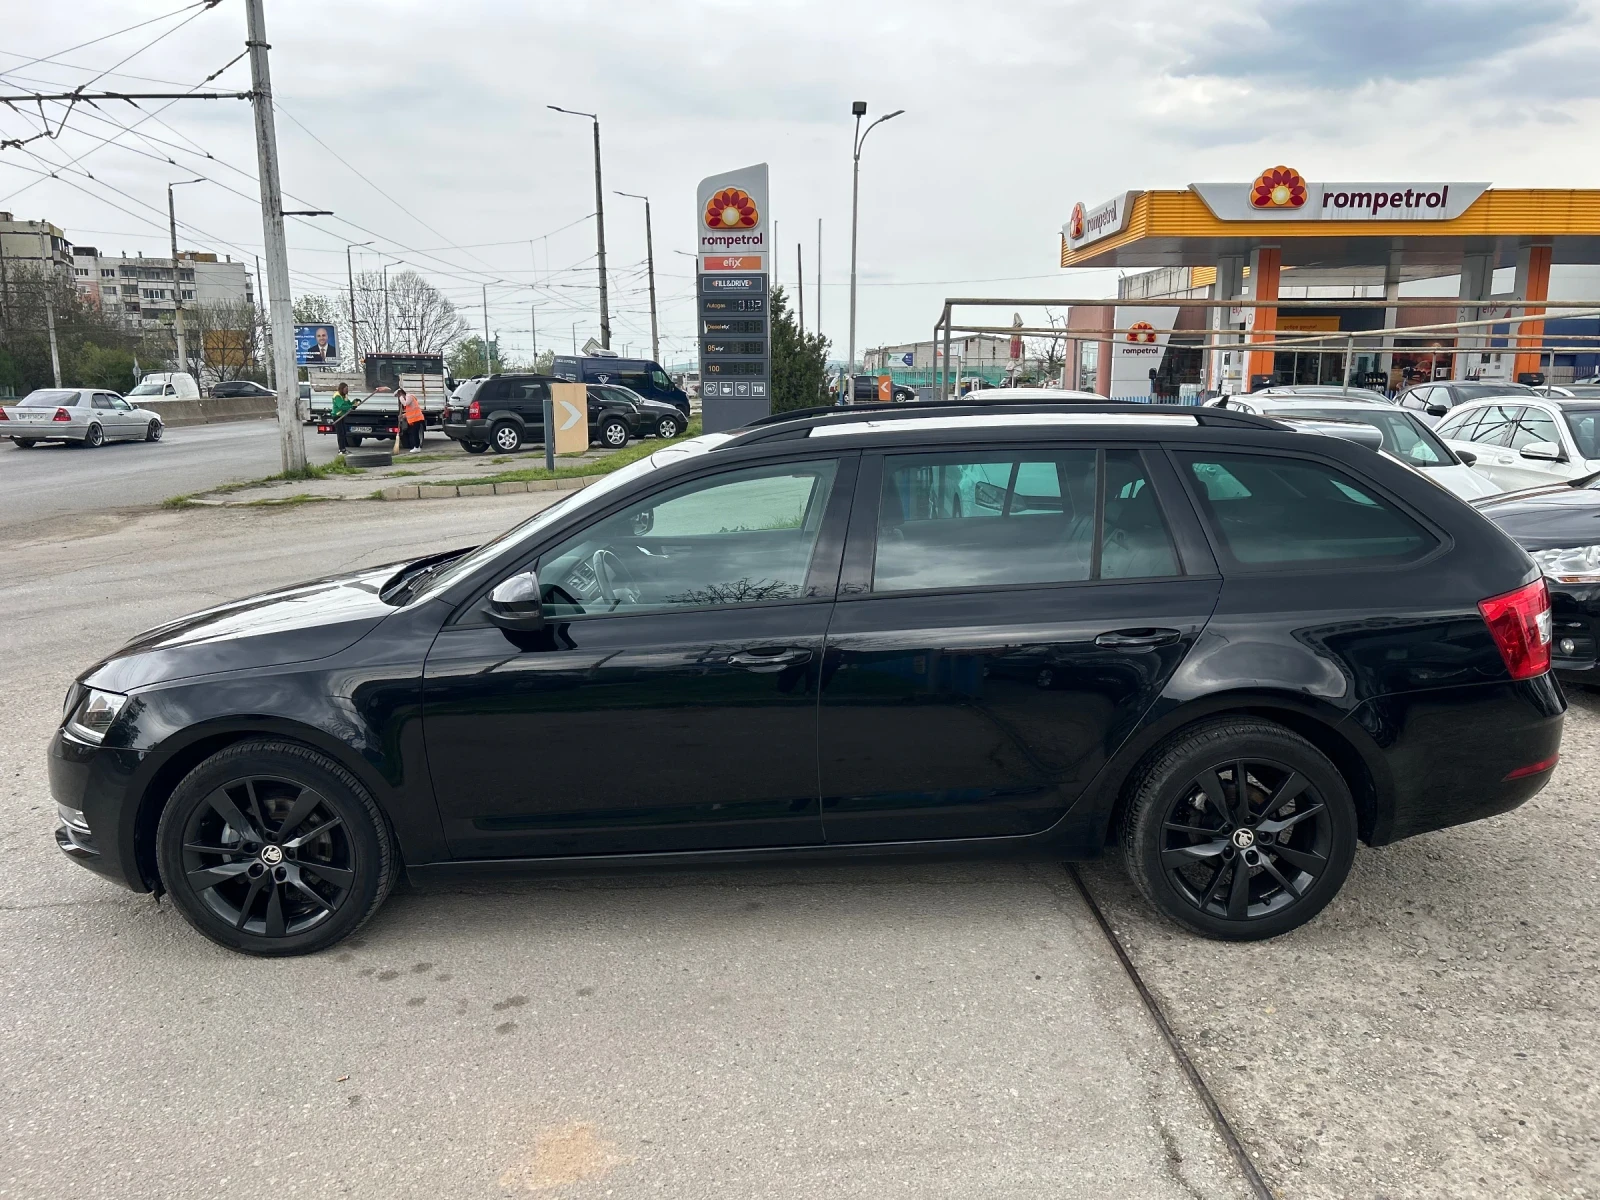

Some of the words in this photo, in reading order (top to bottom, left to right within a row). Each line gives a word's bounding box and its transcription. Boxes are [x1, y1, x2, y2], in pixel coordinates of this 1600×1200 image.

[1322, 185, 1448, 216] rompetrol
[1087, 200, 1117, 234] rompetrol
[702, 233, 763, 248] rompetrol
[723, 257, 743, 268] efix
[1122, 346, 1159, 356] rompetrol
